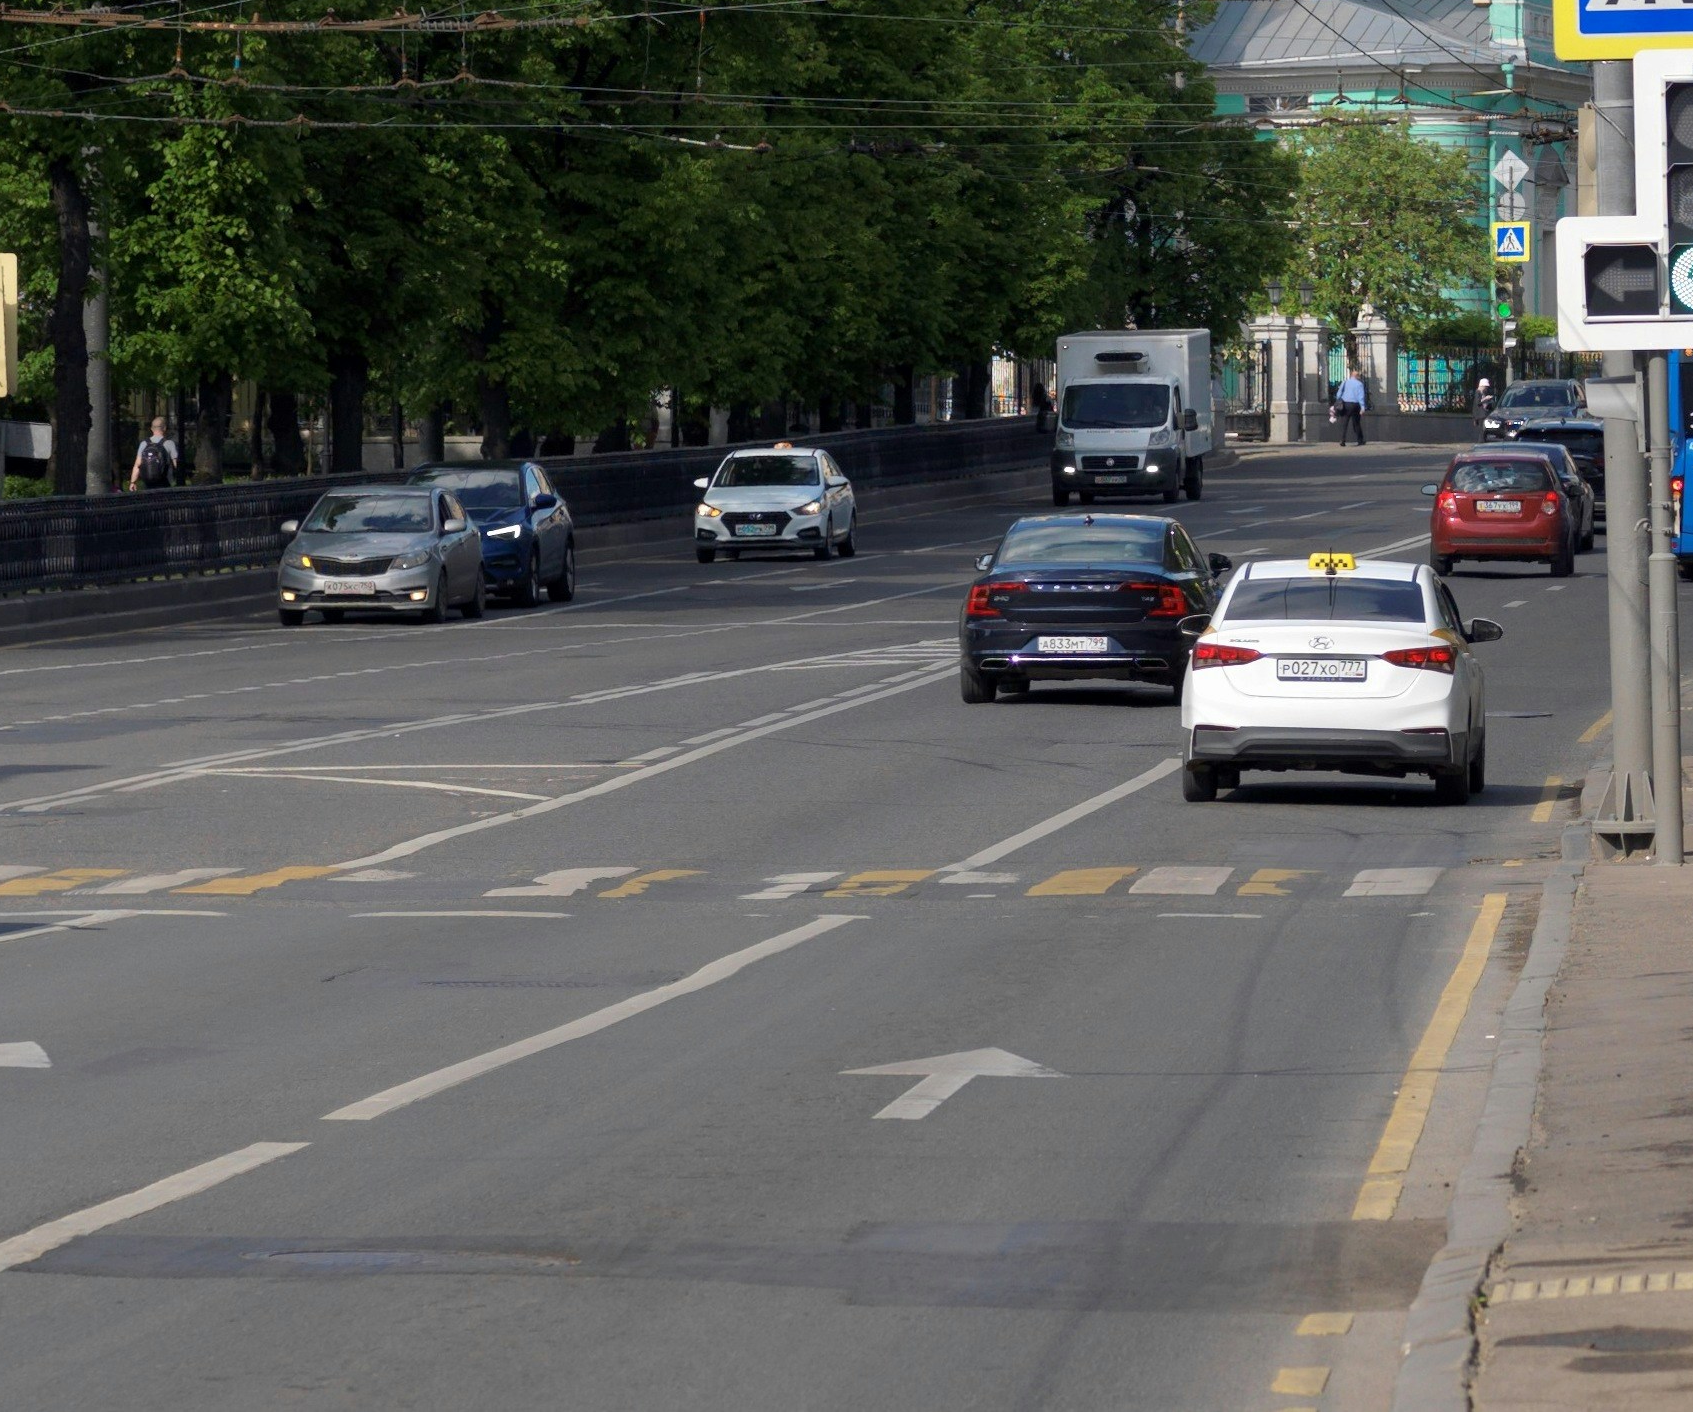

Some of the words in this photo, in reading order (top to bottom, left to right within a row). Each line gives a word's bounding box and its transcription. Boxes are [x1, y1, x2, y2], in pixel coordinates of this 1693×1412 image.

[1042, 638, 1085, 650] А833МТ
[1087, 637, 1104, 647] 799
[1282, 661, 1338, 676] Р027ХО
[1340, 660, 1361, 672] 777
